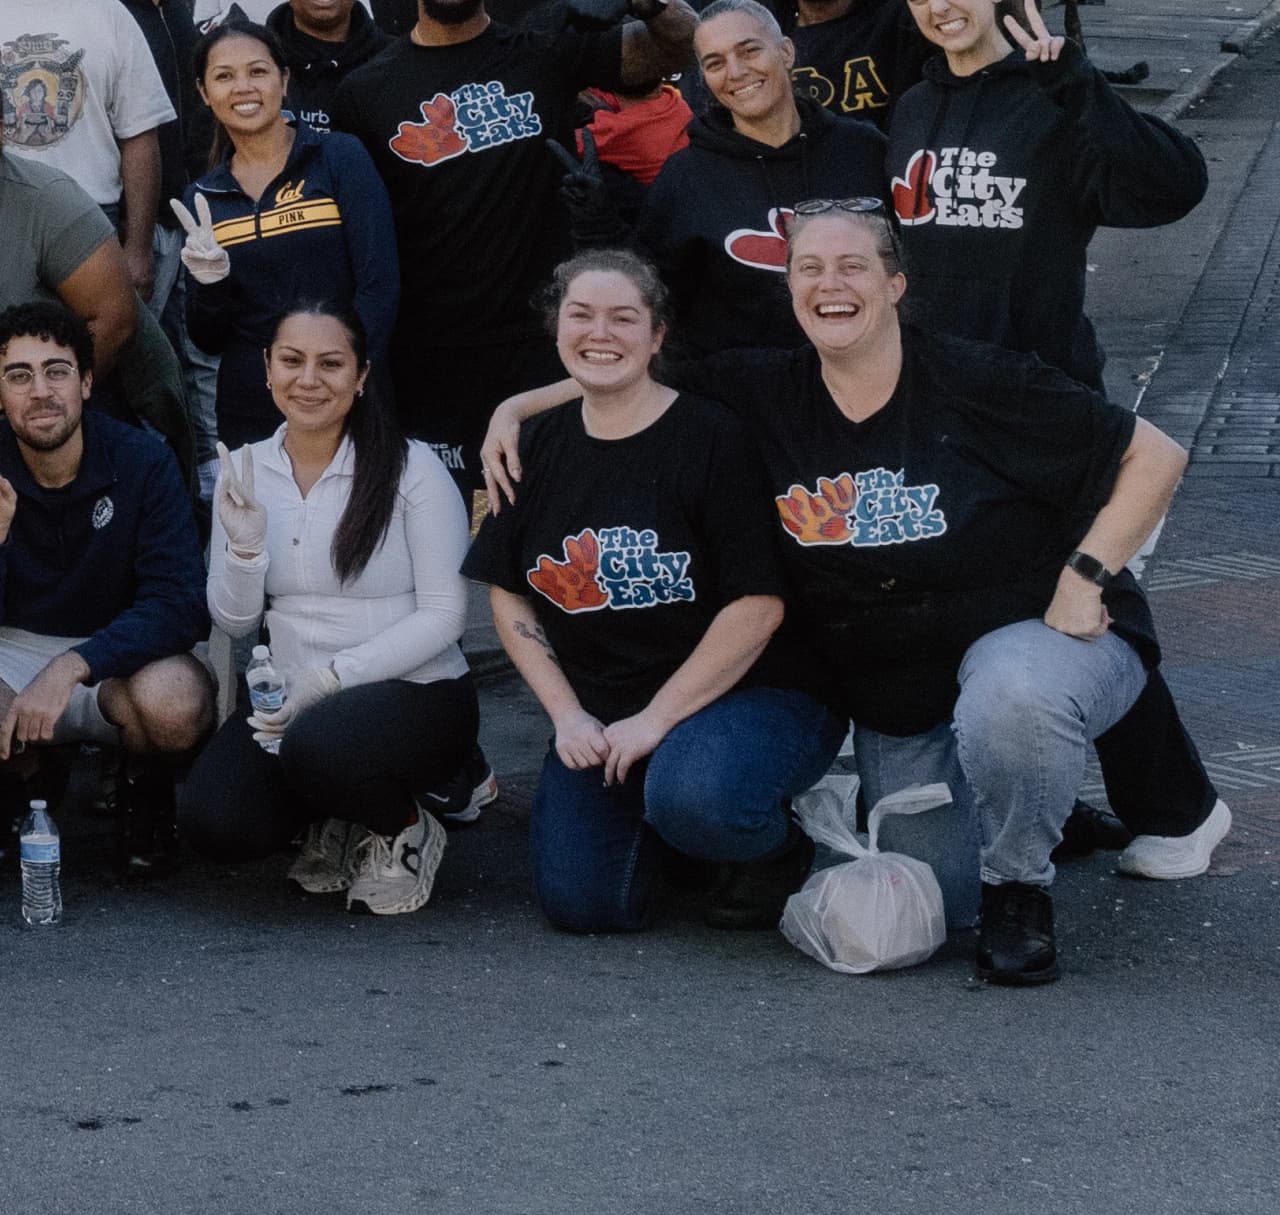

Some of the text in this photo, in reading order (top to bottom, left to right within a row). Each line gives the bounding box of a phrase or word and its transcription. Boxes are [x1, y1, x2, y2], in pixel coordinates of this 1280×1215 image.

[453, 82, 502, 106] The
[300, 109, 330, 124] urb
[456, 92, 533, 129] City
[464, 115, 541, 151] Eats
[940, 147, 998, 168] The
[274, 179, 305, 208] Cal
[932, 166, 1028, 212] City
[279, 210, 305, 225] PINK
[935, 196, 1025, 230] Eats
[855, 485, 937, 522] City
[599, 527, 656, 549] The
[853, 510, 945, 546] Eats
[599, 547, 689, 588] City
[605, 577, 694, 608] Eats
